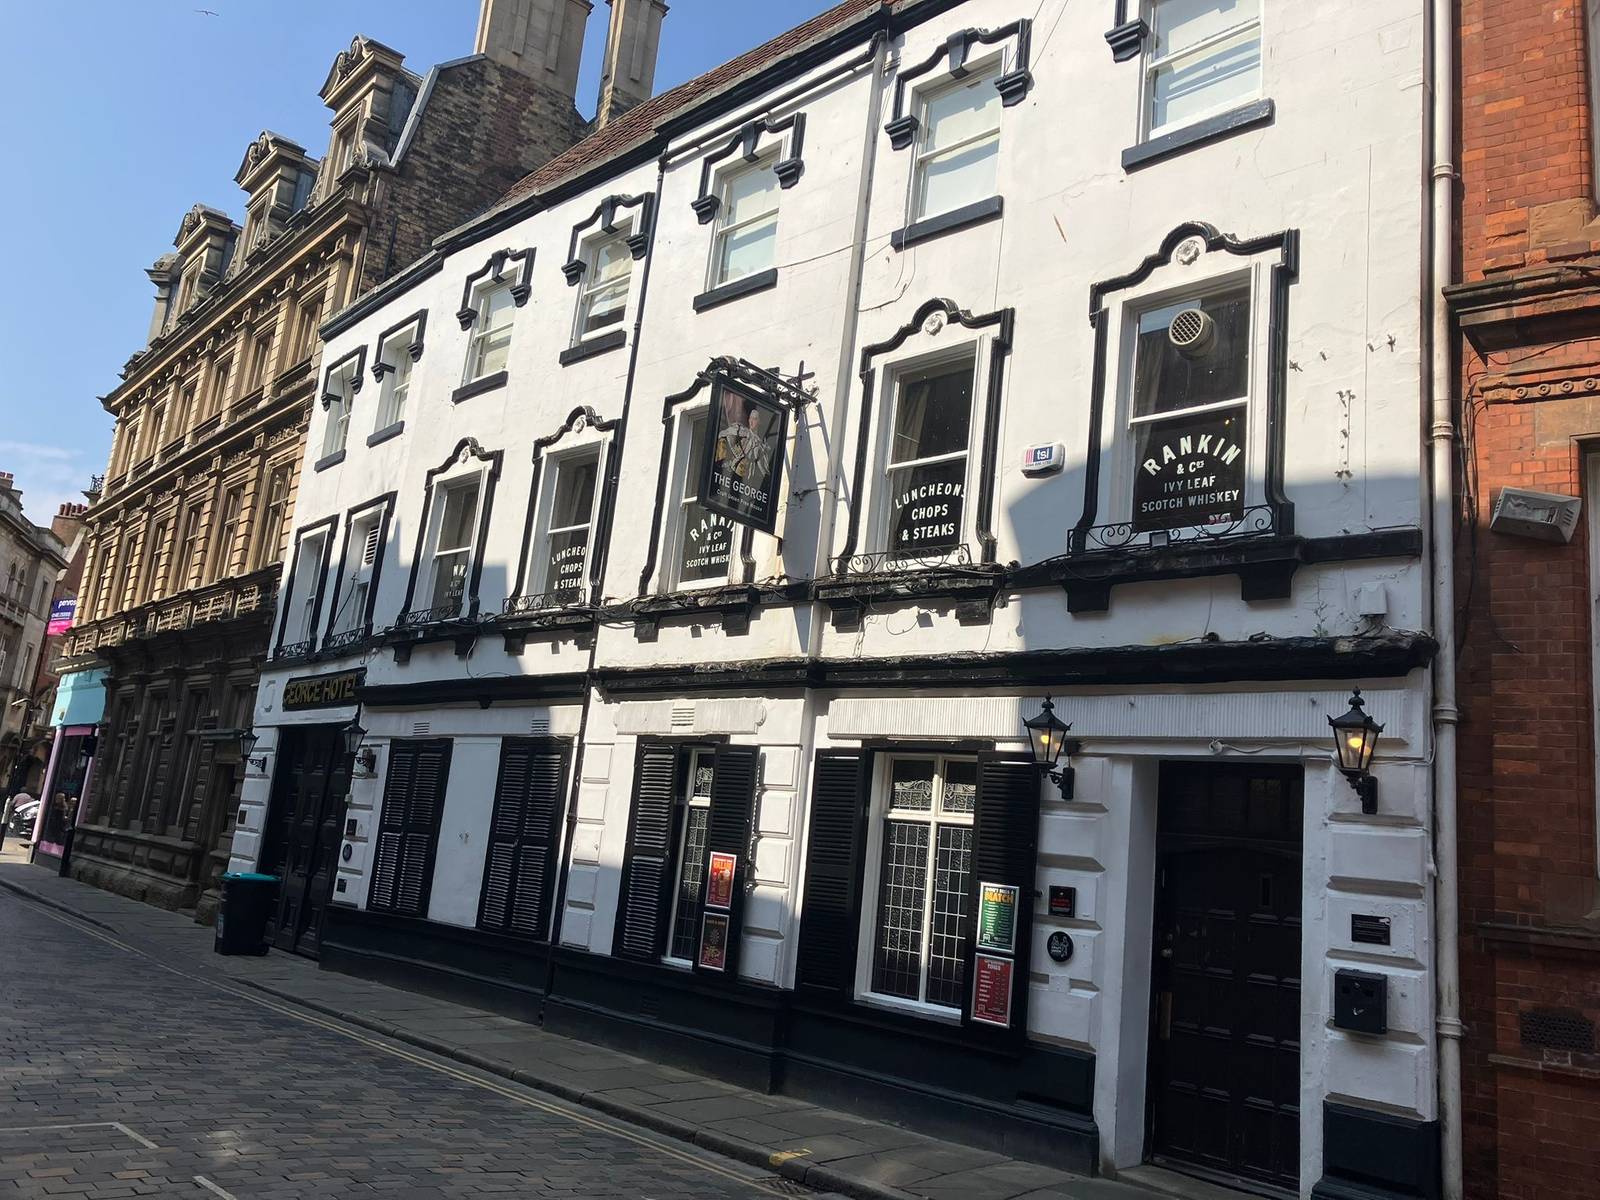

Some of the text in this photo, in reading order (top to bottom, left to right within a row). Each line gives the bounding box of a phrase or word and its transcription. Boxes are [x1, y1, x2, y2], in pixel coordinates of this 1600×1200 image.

[1143, 434, 1241, 476] RANKIN
[1176, 463, 1184, 474] &
[714, 471, 768, 504] THE GEORGE
[1164, 475, 1216, 493] IVY LEAF
[1141, 489, 1240, 512] SCOTCH WHISKEY
[911, 503, 949, 521] CHOPS
[901, 522, 955, 542] & STEAKS
[551, 546, 586, 565] LUNCHEO
[699, 542, 728, 554] IVY LEAF
[560, 562, 583, 574] CHOPS
[686, 554, 730, 568] SCOTCH WHISK
[560, 577, 582, 589] STEAK
[984, 892, 1014, 903] MATCH
